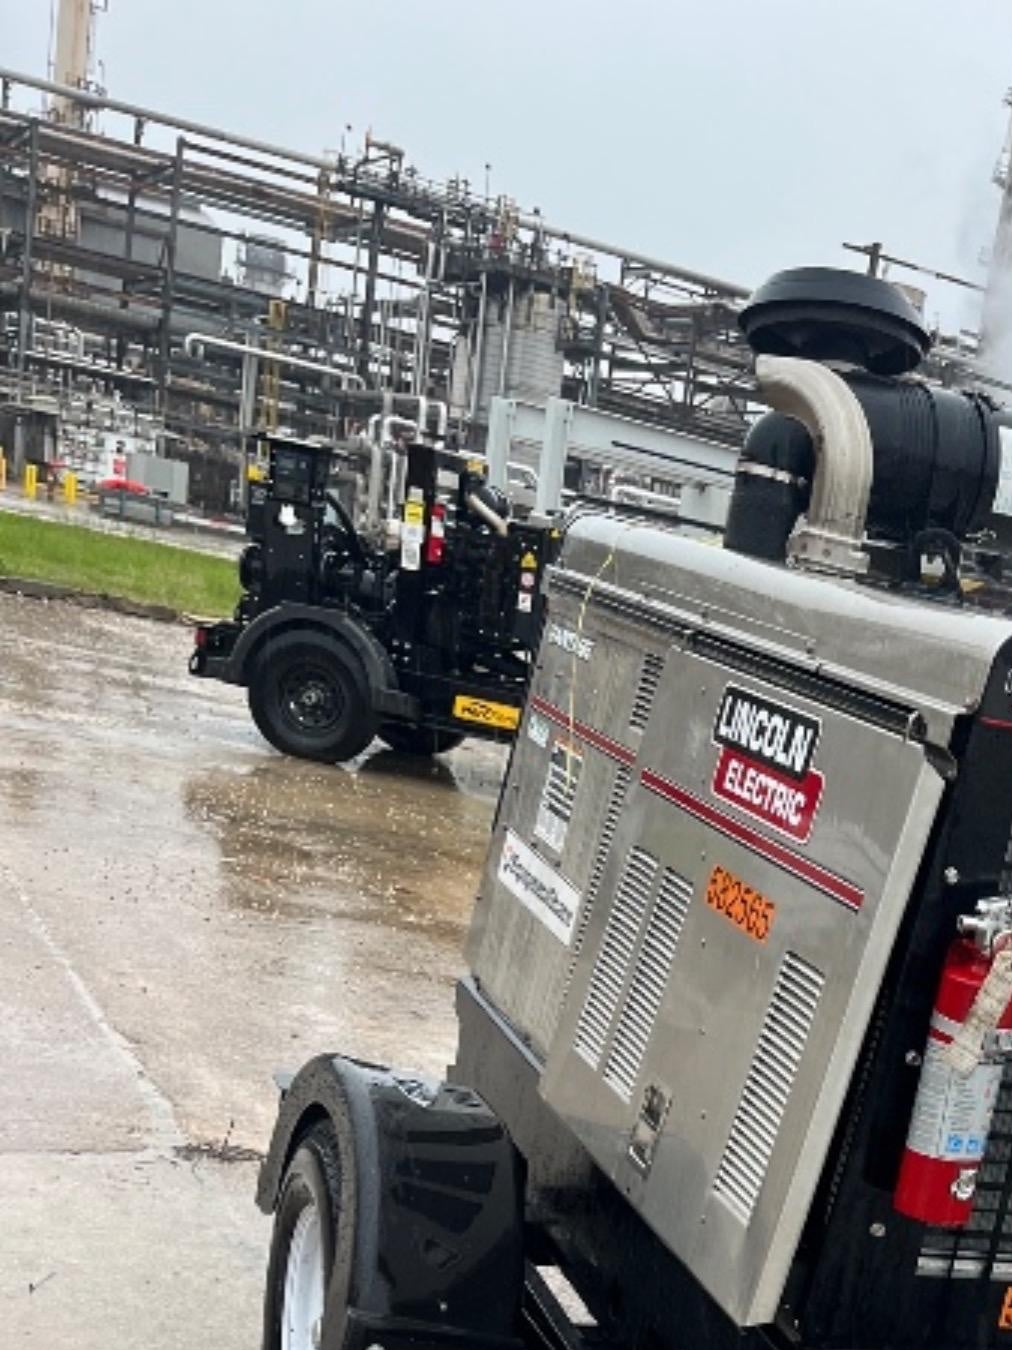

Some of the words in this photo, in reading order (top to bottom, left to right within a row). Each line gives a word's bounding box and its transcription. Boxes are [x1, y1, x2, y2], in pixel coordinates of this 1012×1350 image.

[718, 695, 814, 773] LINCOLN
[722, 758, 808, 827] ELECTRIC
[707, 865, 775, 941] 582565
